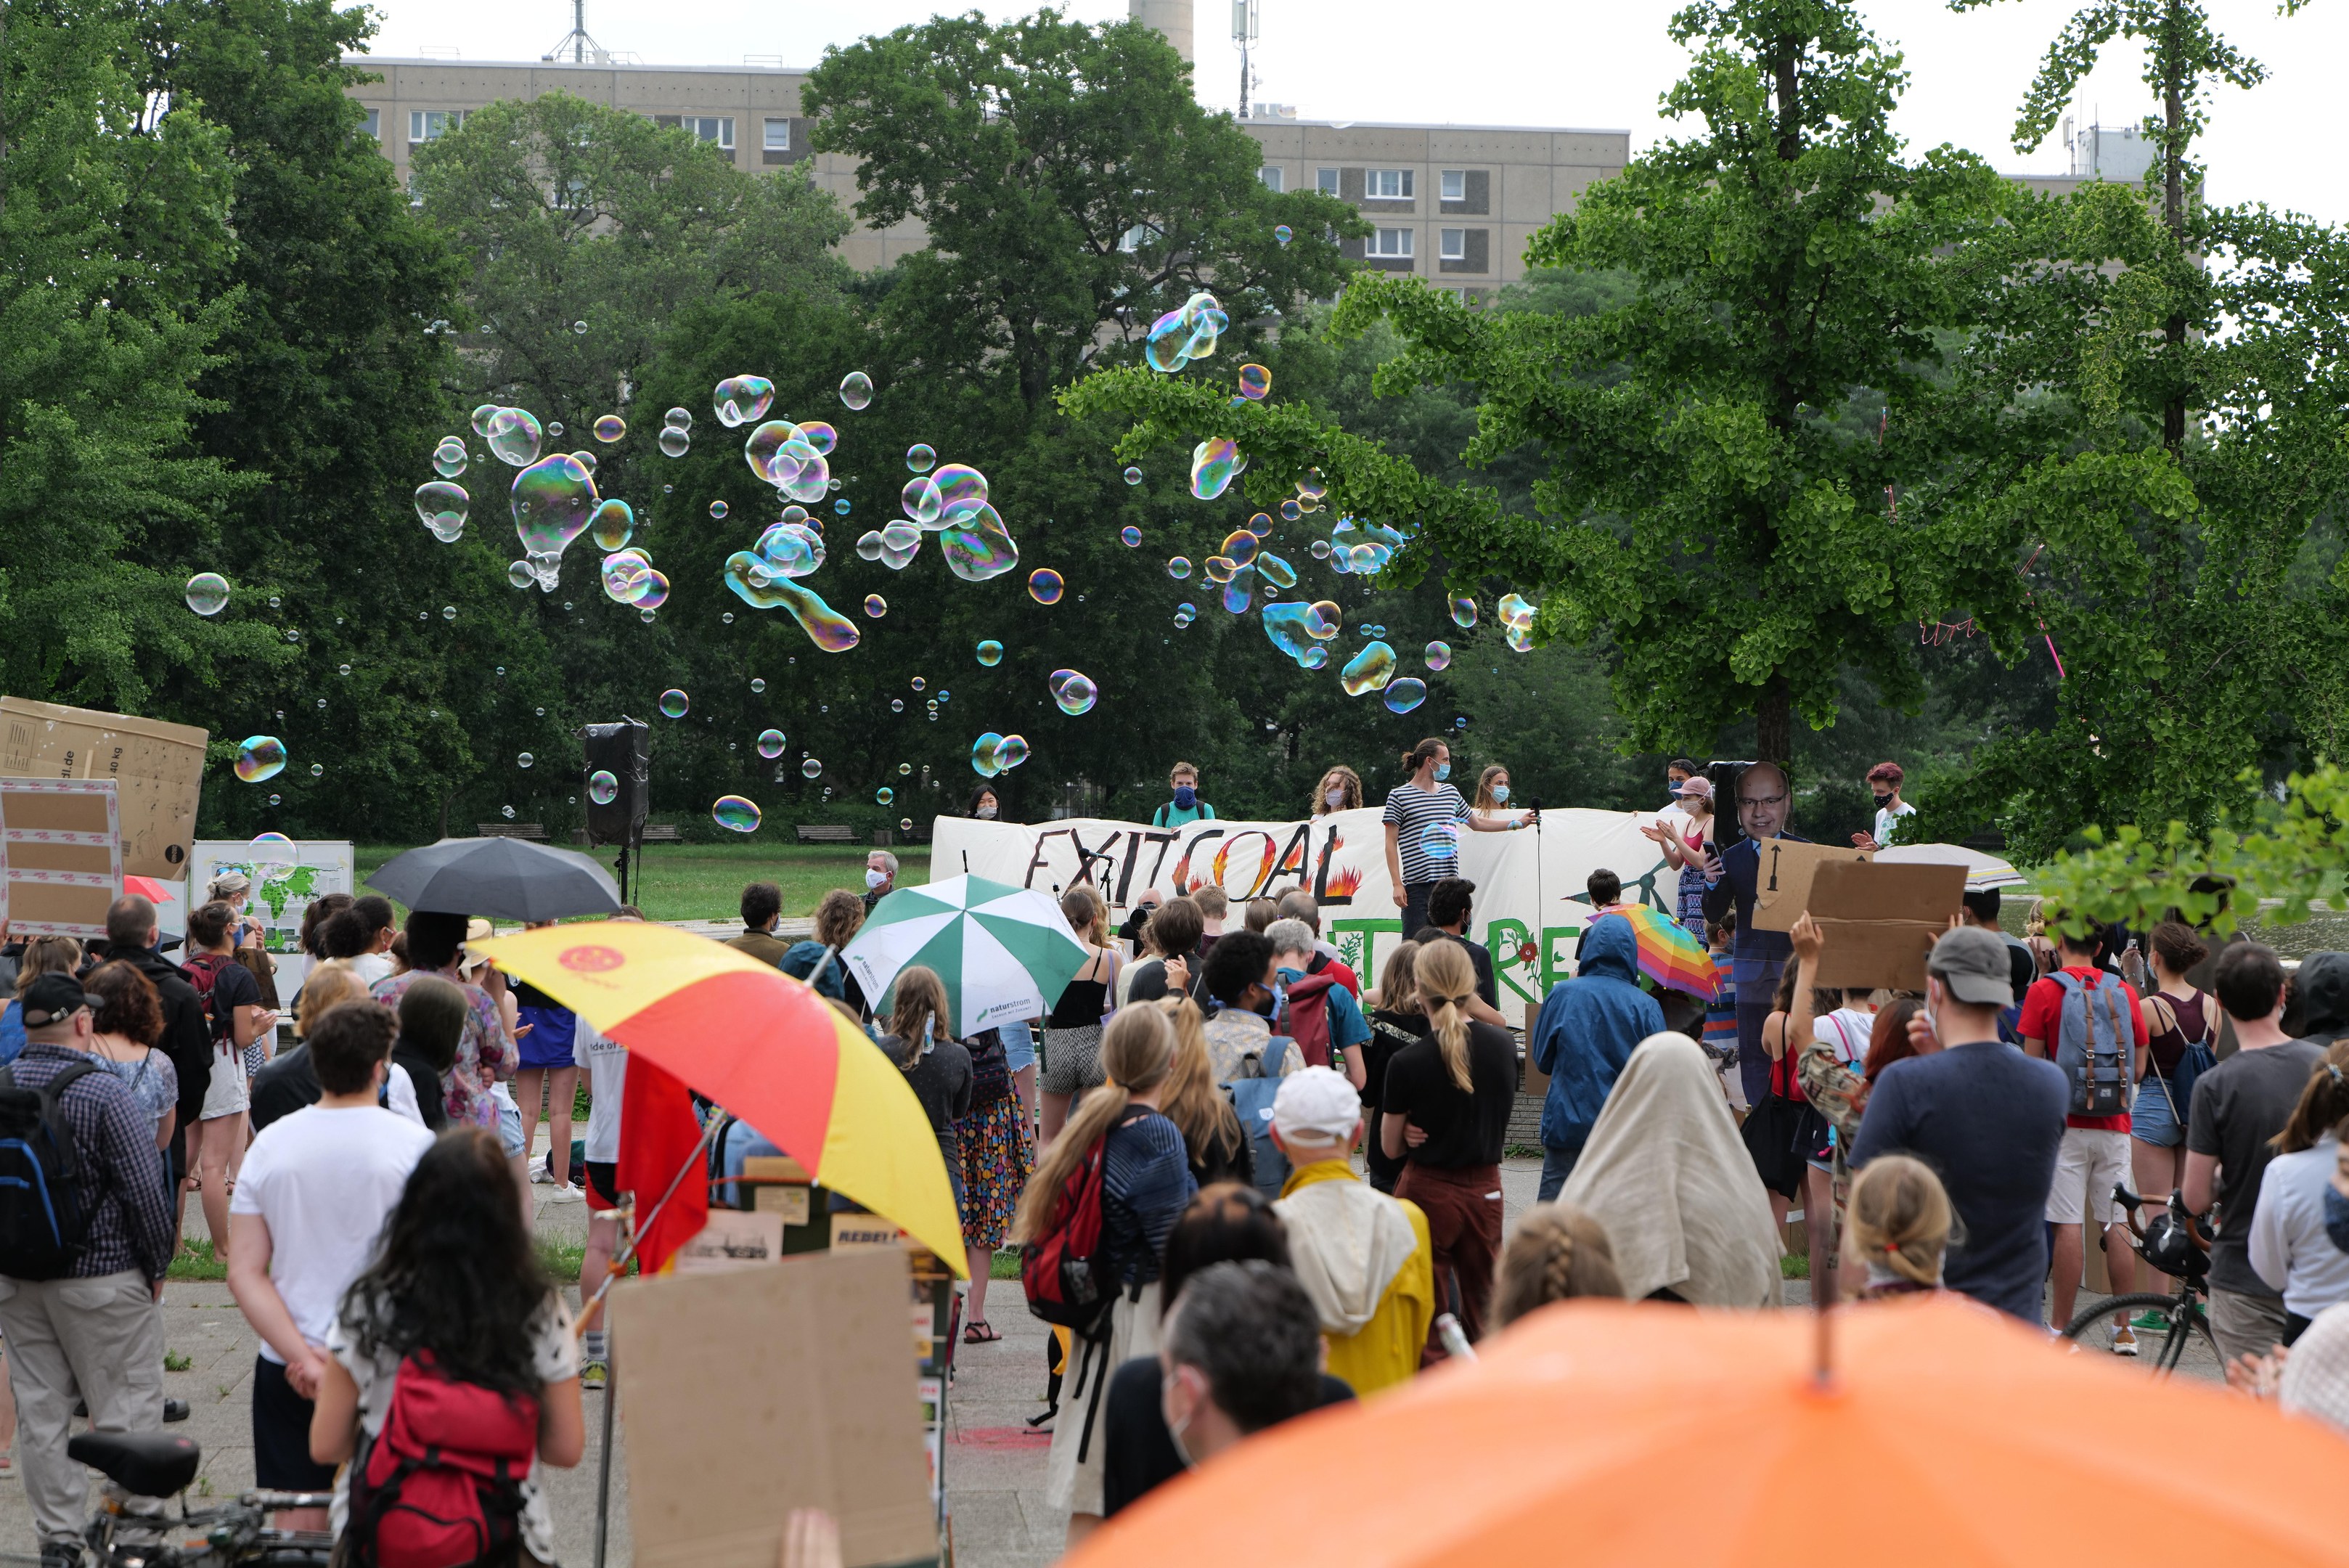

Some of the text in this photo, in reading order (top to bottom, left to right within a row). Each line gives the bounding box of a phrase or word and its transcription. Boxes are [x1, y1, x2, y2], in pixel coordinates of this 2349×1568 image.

[112, 747, 123, 759] kg
[862, 960, 879, 989] naturstrom
[990, 998, 1031, 1013] naturstrom
